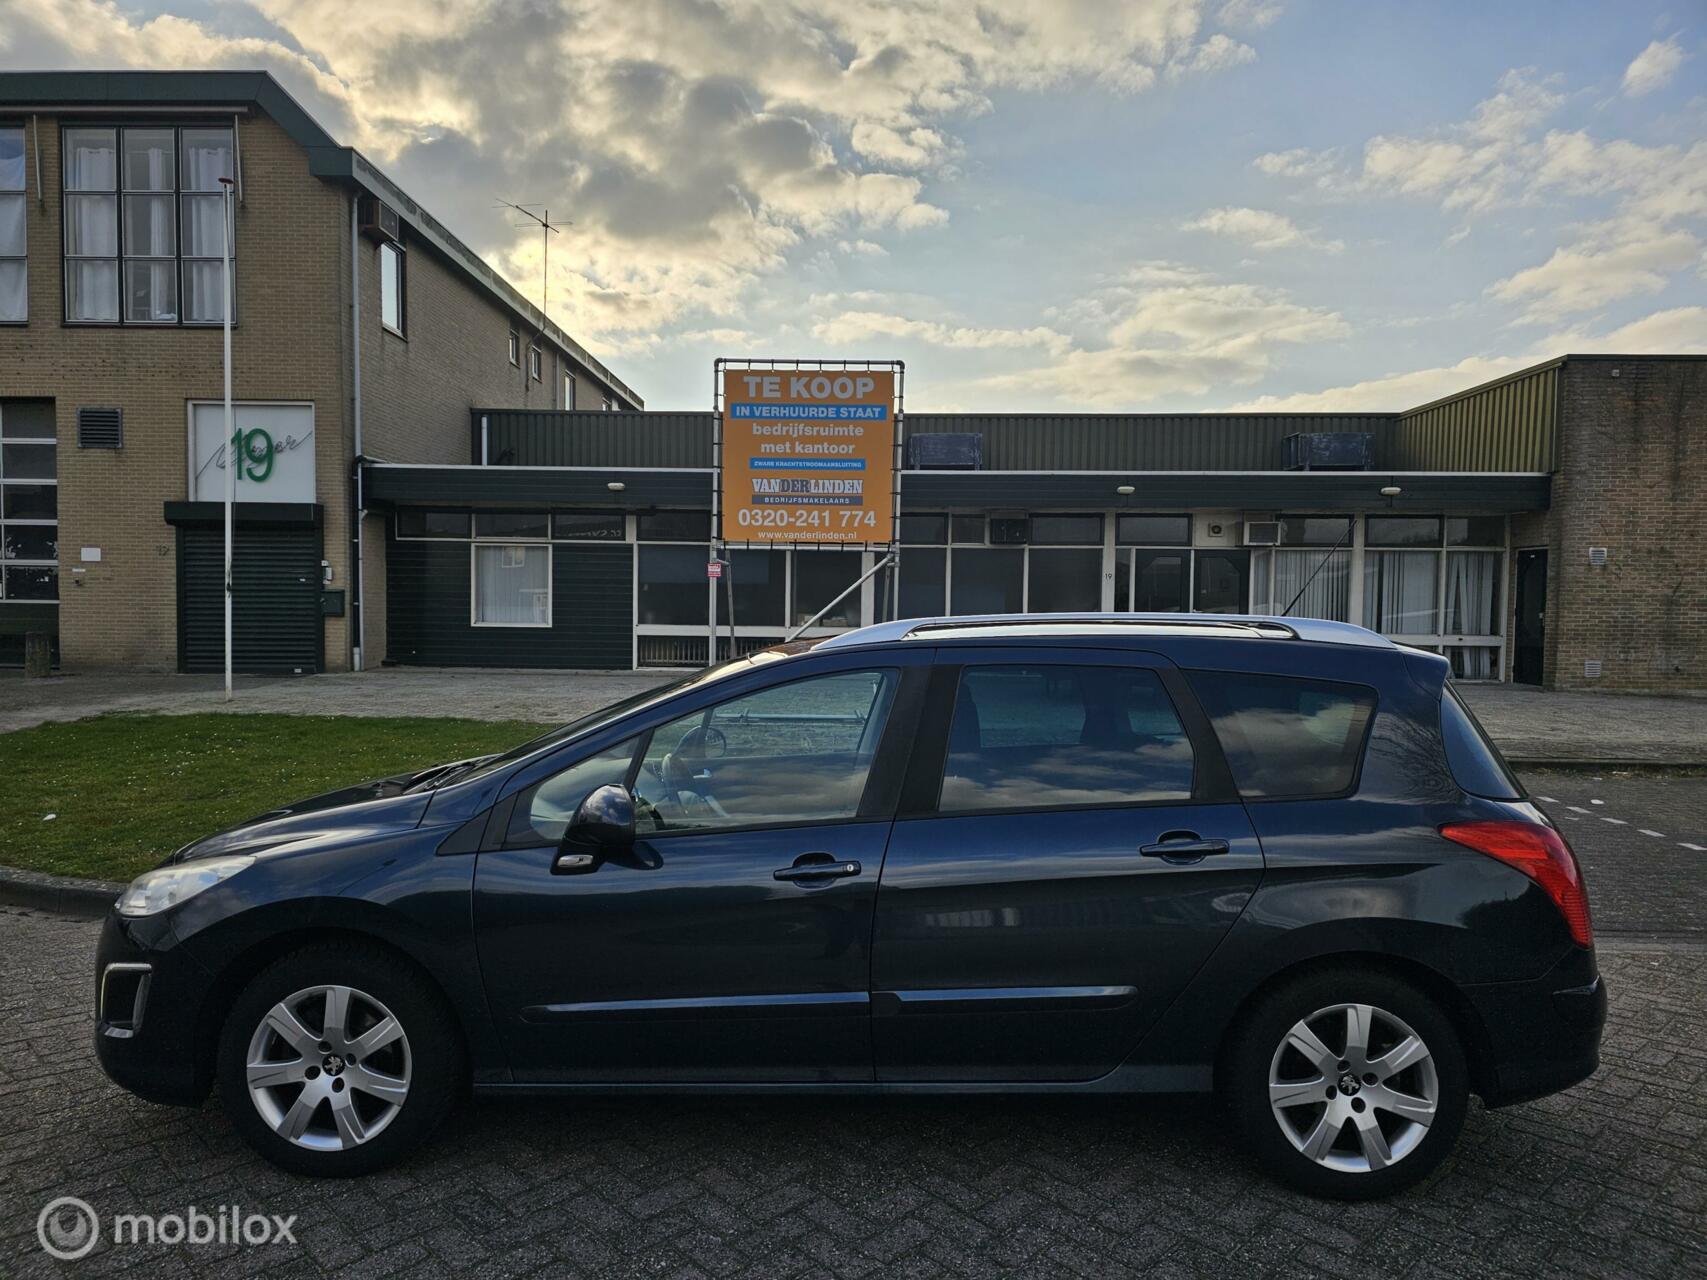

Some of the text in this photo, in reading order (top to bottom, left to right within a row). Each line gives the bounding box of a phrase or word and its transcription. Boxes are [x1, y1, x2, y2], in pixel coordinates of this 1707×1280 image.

[744, 376, 875, 399] TE KOOP
[736, 406, 881, 418] IN VERHUURDE STAAT
[752, 423, 864, 438] bedrijfsruimte
[760, 441, 856, 454] met kantoor
[231, 428, 273, 483] 19
[738, 509, 876, 528] 0320-241 774
[757, 531, 857, 539] www.vanderlinden.nl
